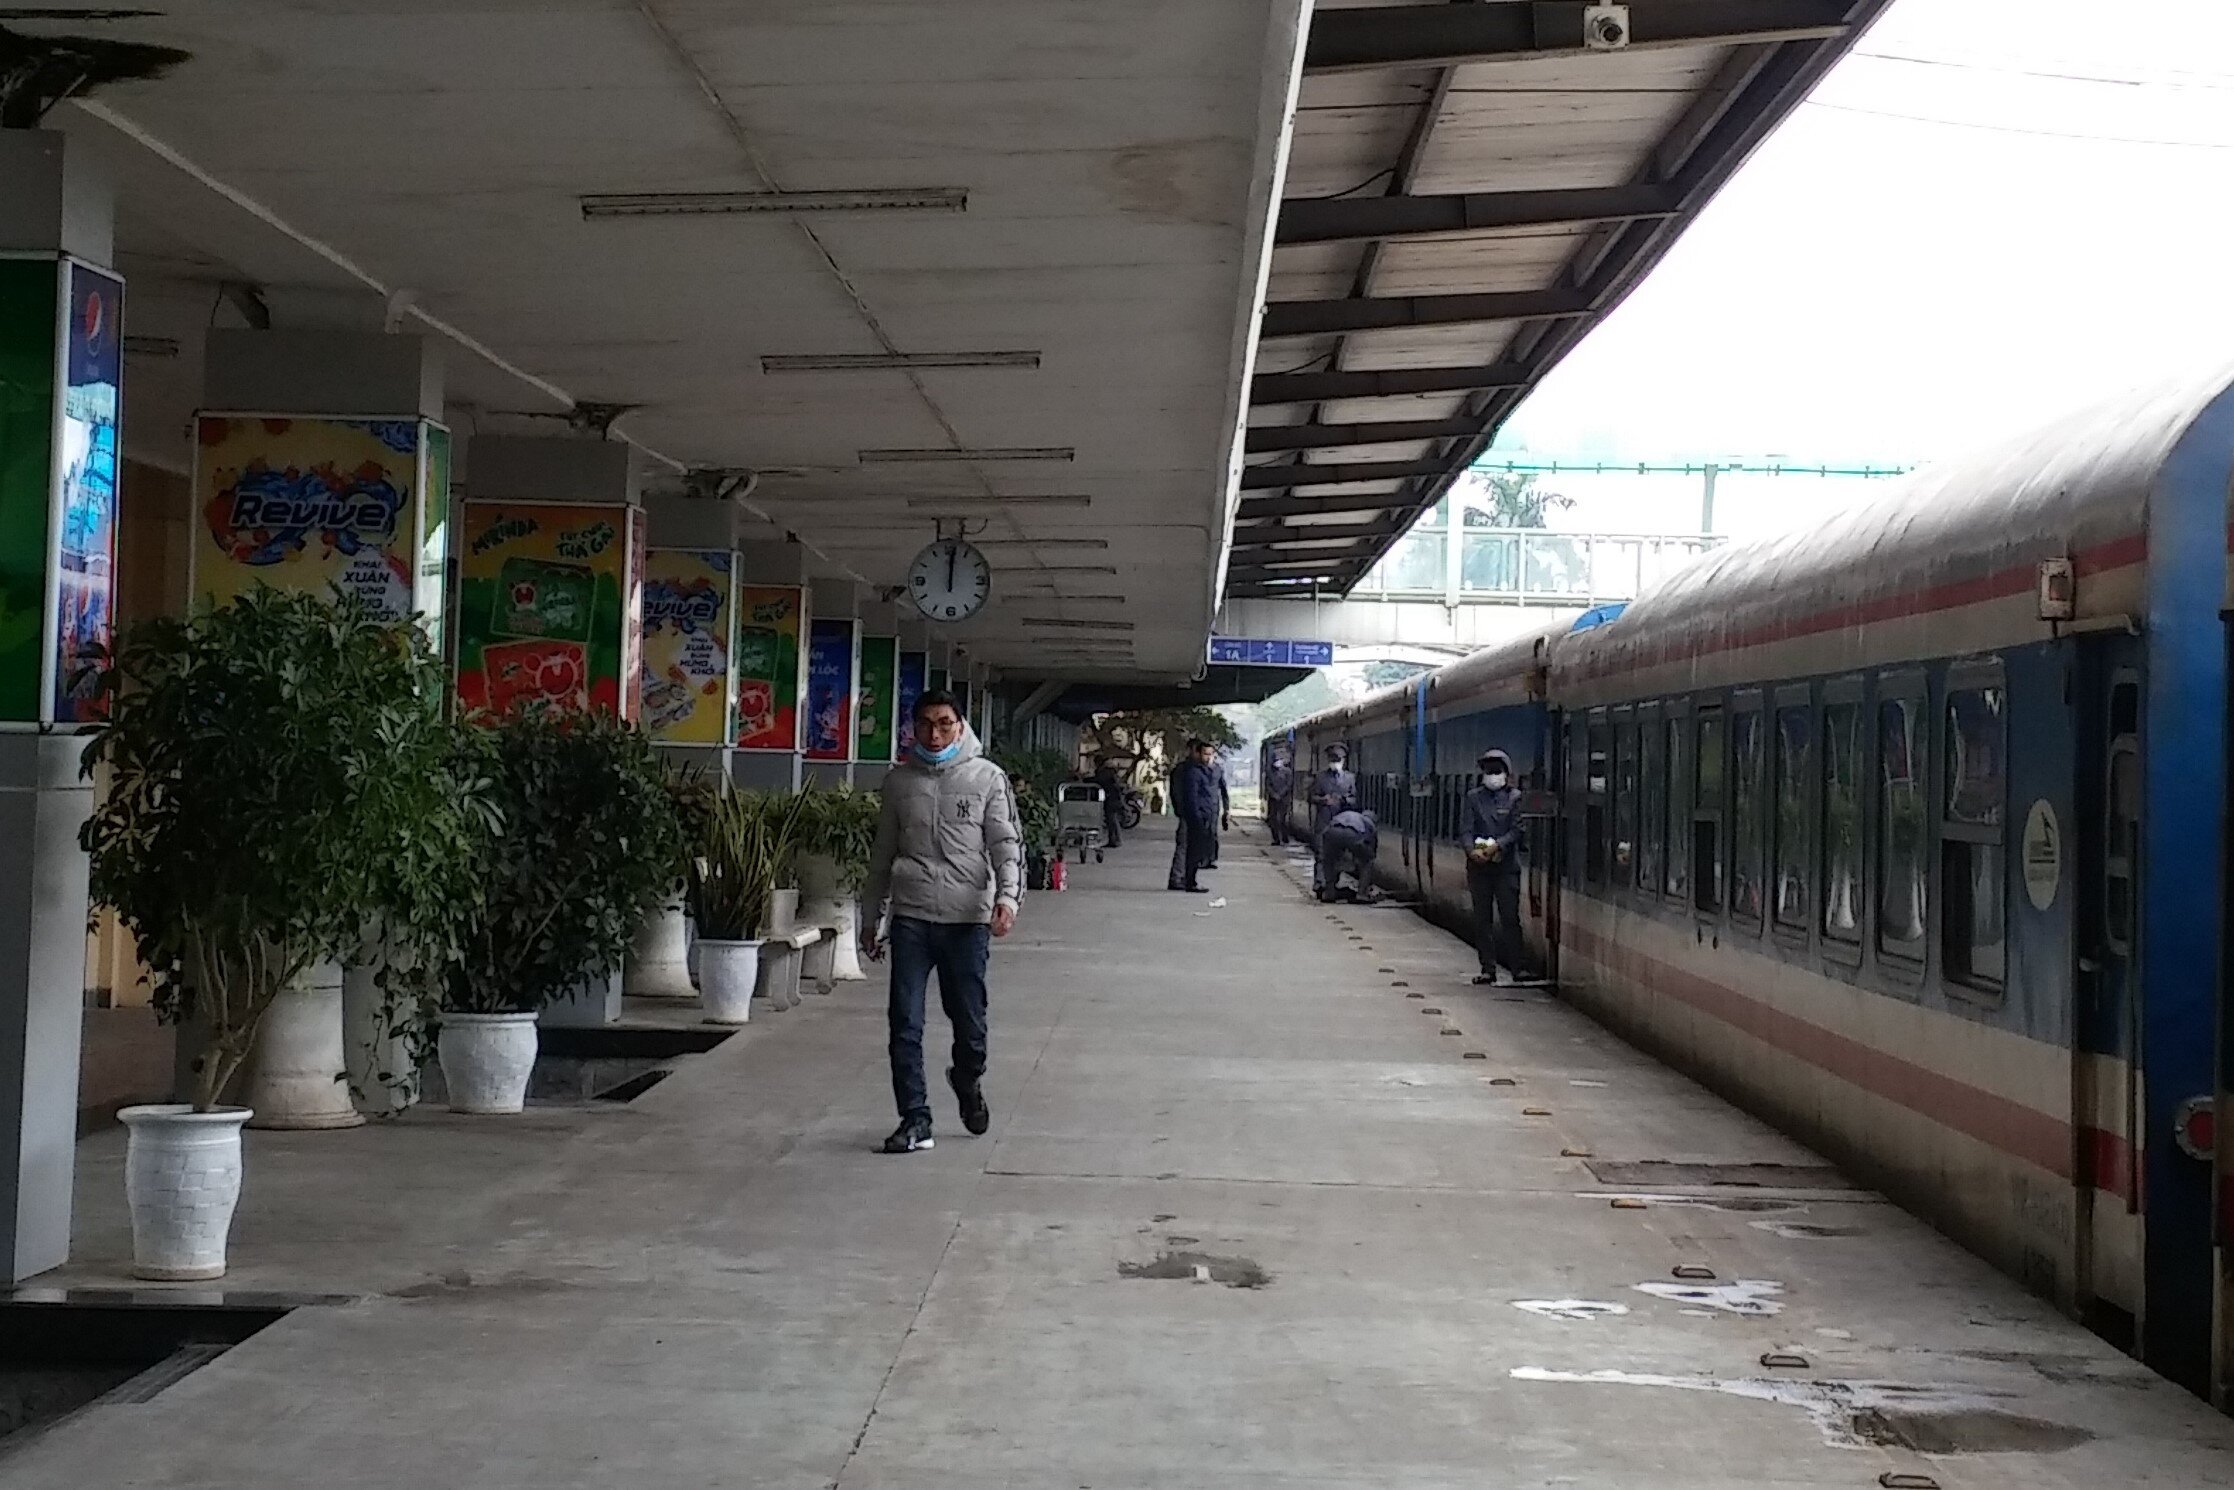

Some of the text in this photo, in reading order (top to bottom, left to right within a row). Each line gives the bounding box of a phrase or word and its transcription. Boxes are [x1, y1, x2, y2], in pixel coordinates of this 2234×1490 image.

[231, 494, 387, 528] Revive
[644, 602, 712, 618] evive
[946, 606, 956, 617] 6
